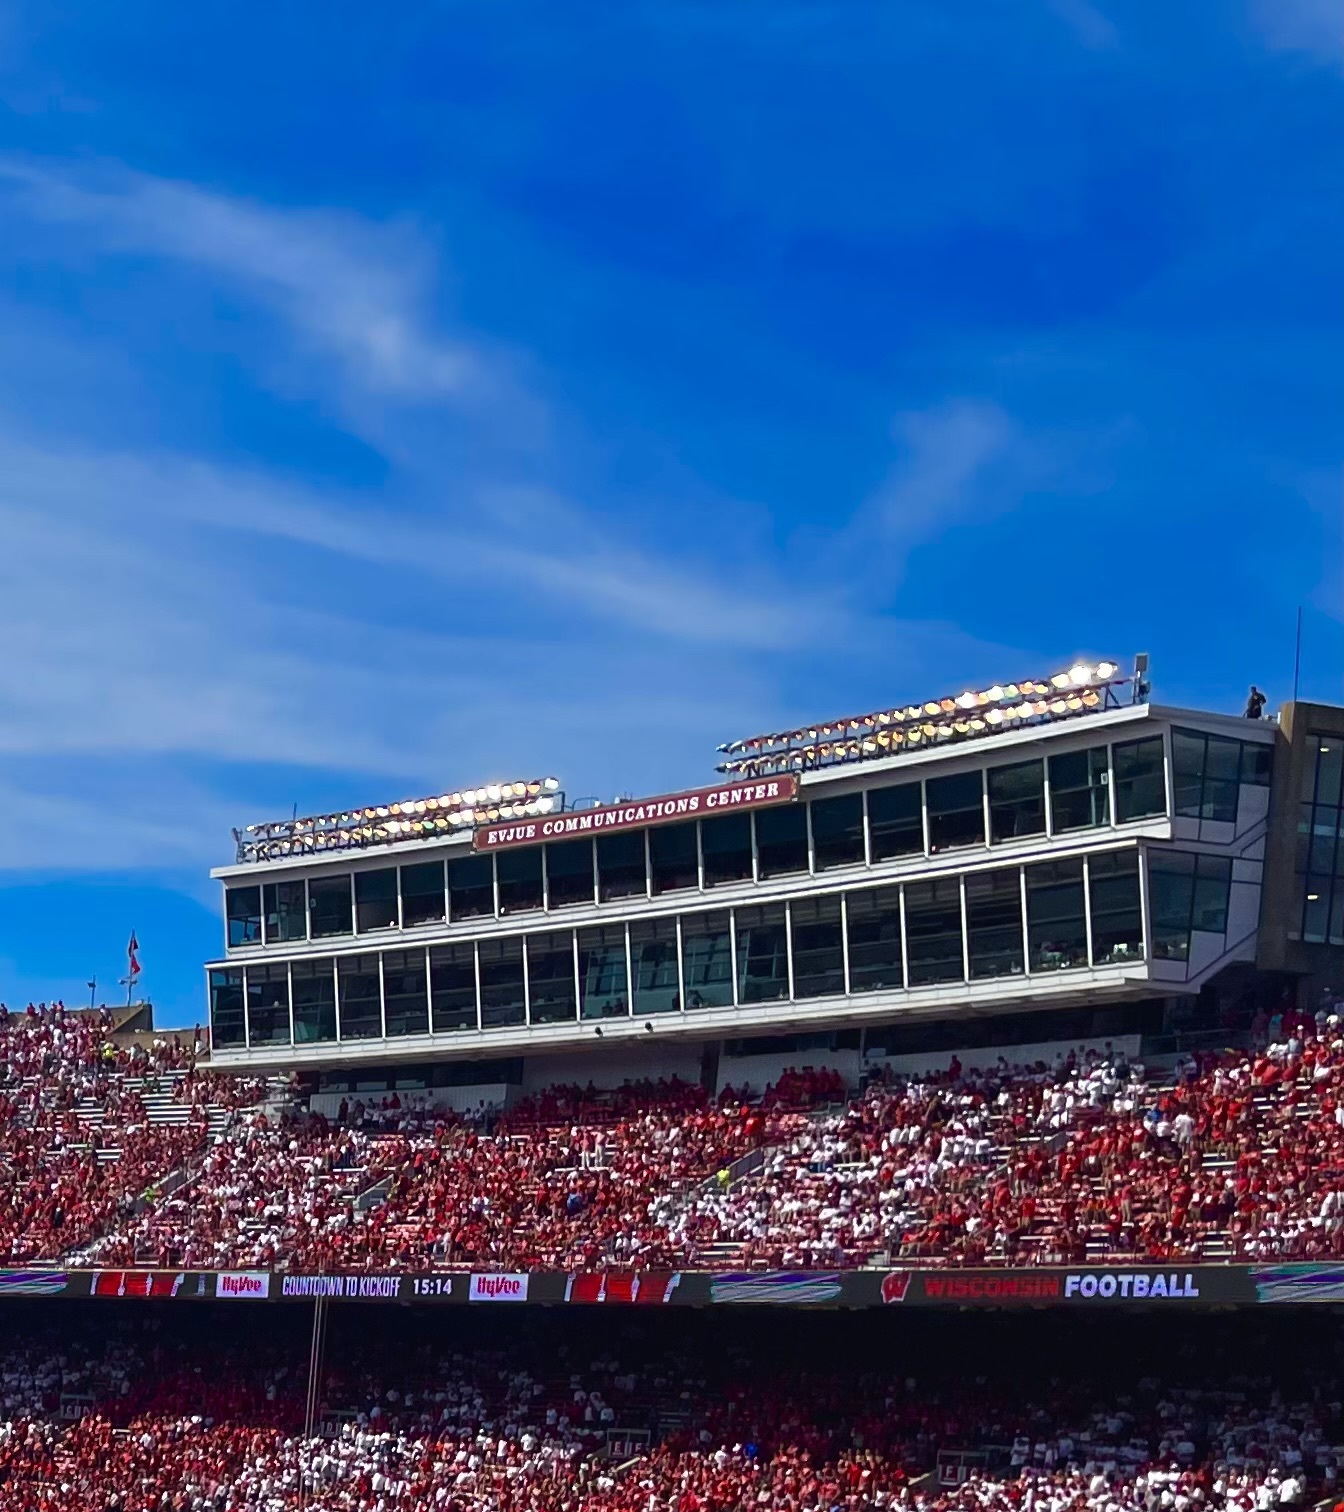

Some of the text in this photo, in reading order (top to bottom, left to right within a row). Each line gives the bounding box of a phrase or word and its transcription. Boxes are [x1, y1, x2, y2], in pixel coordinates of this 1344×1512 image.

[488, 782, 779, 844] EVJUE COMMUNICATIONS CENTER
[282, 1275, 453, 1298] COUNTDOWN TO KICKOFF 15:14
[923, 1276, 1059, 1298] WISCONSIN
[1064, 1273, 1200, 1298] FOOTBALL
